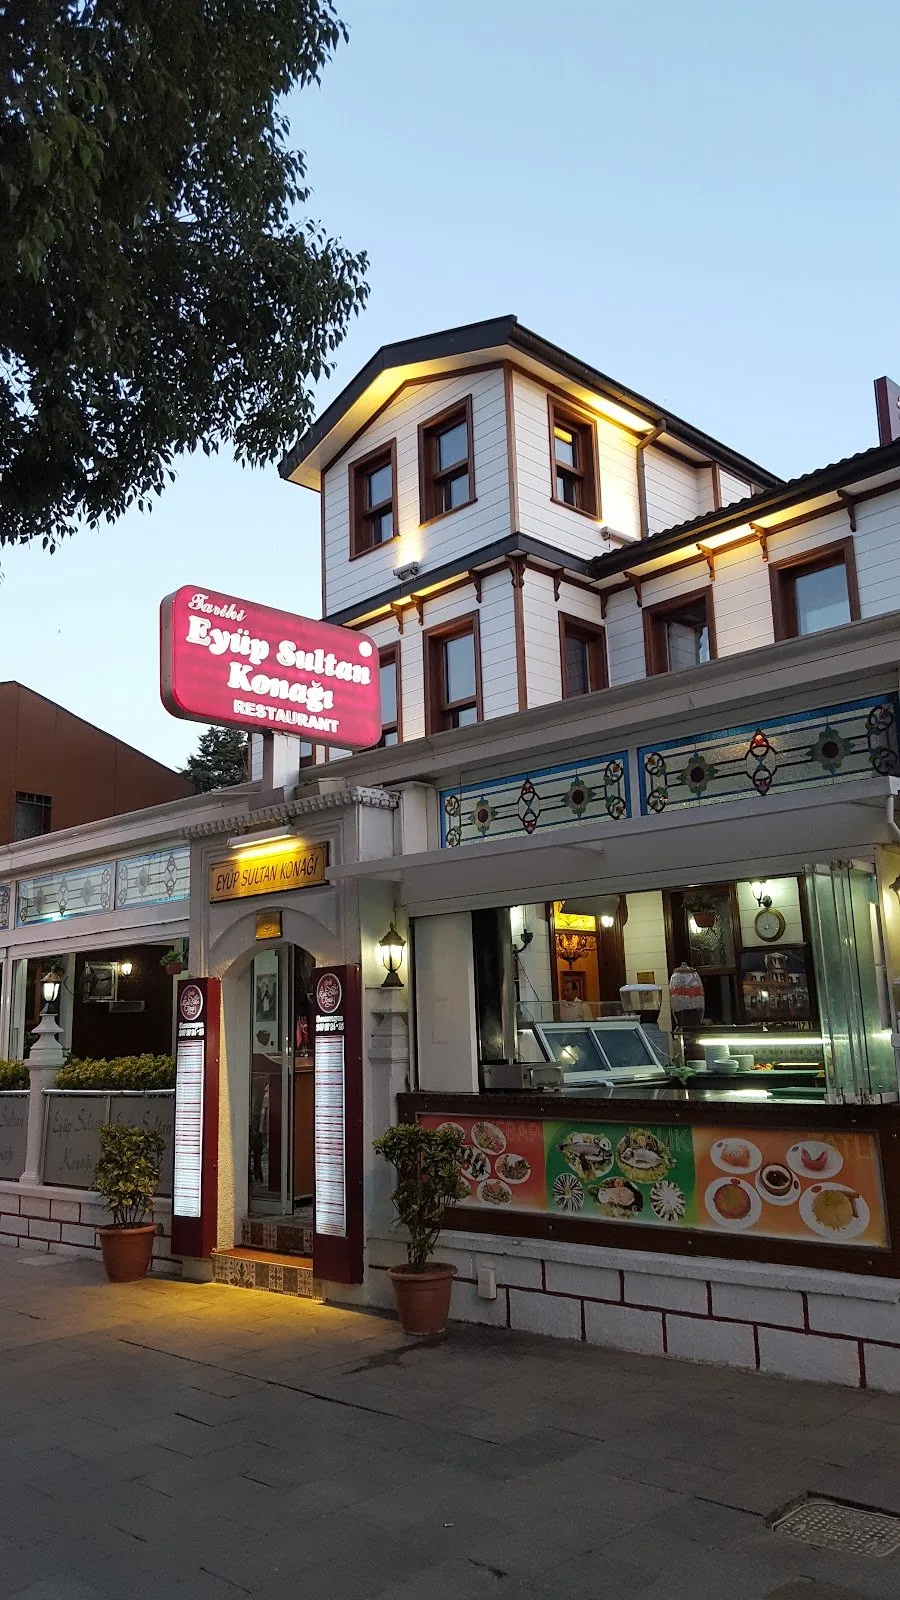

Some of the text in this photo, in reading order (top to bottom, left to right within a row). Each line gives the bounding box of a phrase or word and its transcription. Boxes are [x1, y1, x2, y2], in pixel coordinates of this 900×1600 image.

[188, 593, 247, 622] Tarihi
[185, 615, 371, 685] Eyüp Sultan
[227, 662, 334, 713] Konağı
[233, 699, 339, 733] RESTAURANT
[216, 854, 319, 892] EYÜP SULTAN KONAĞI
